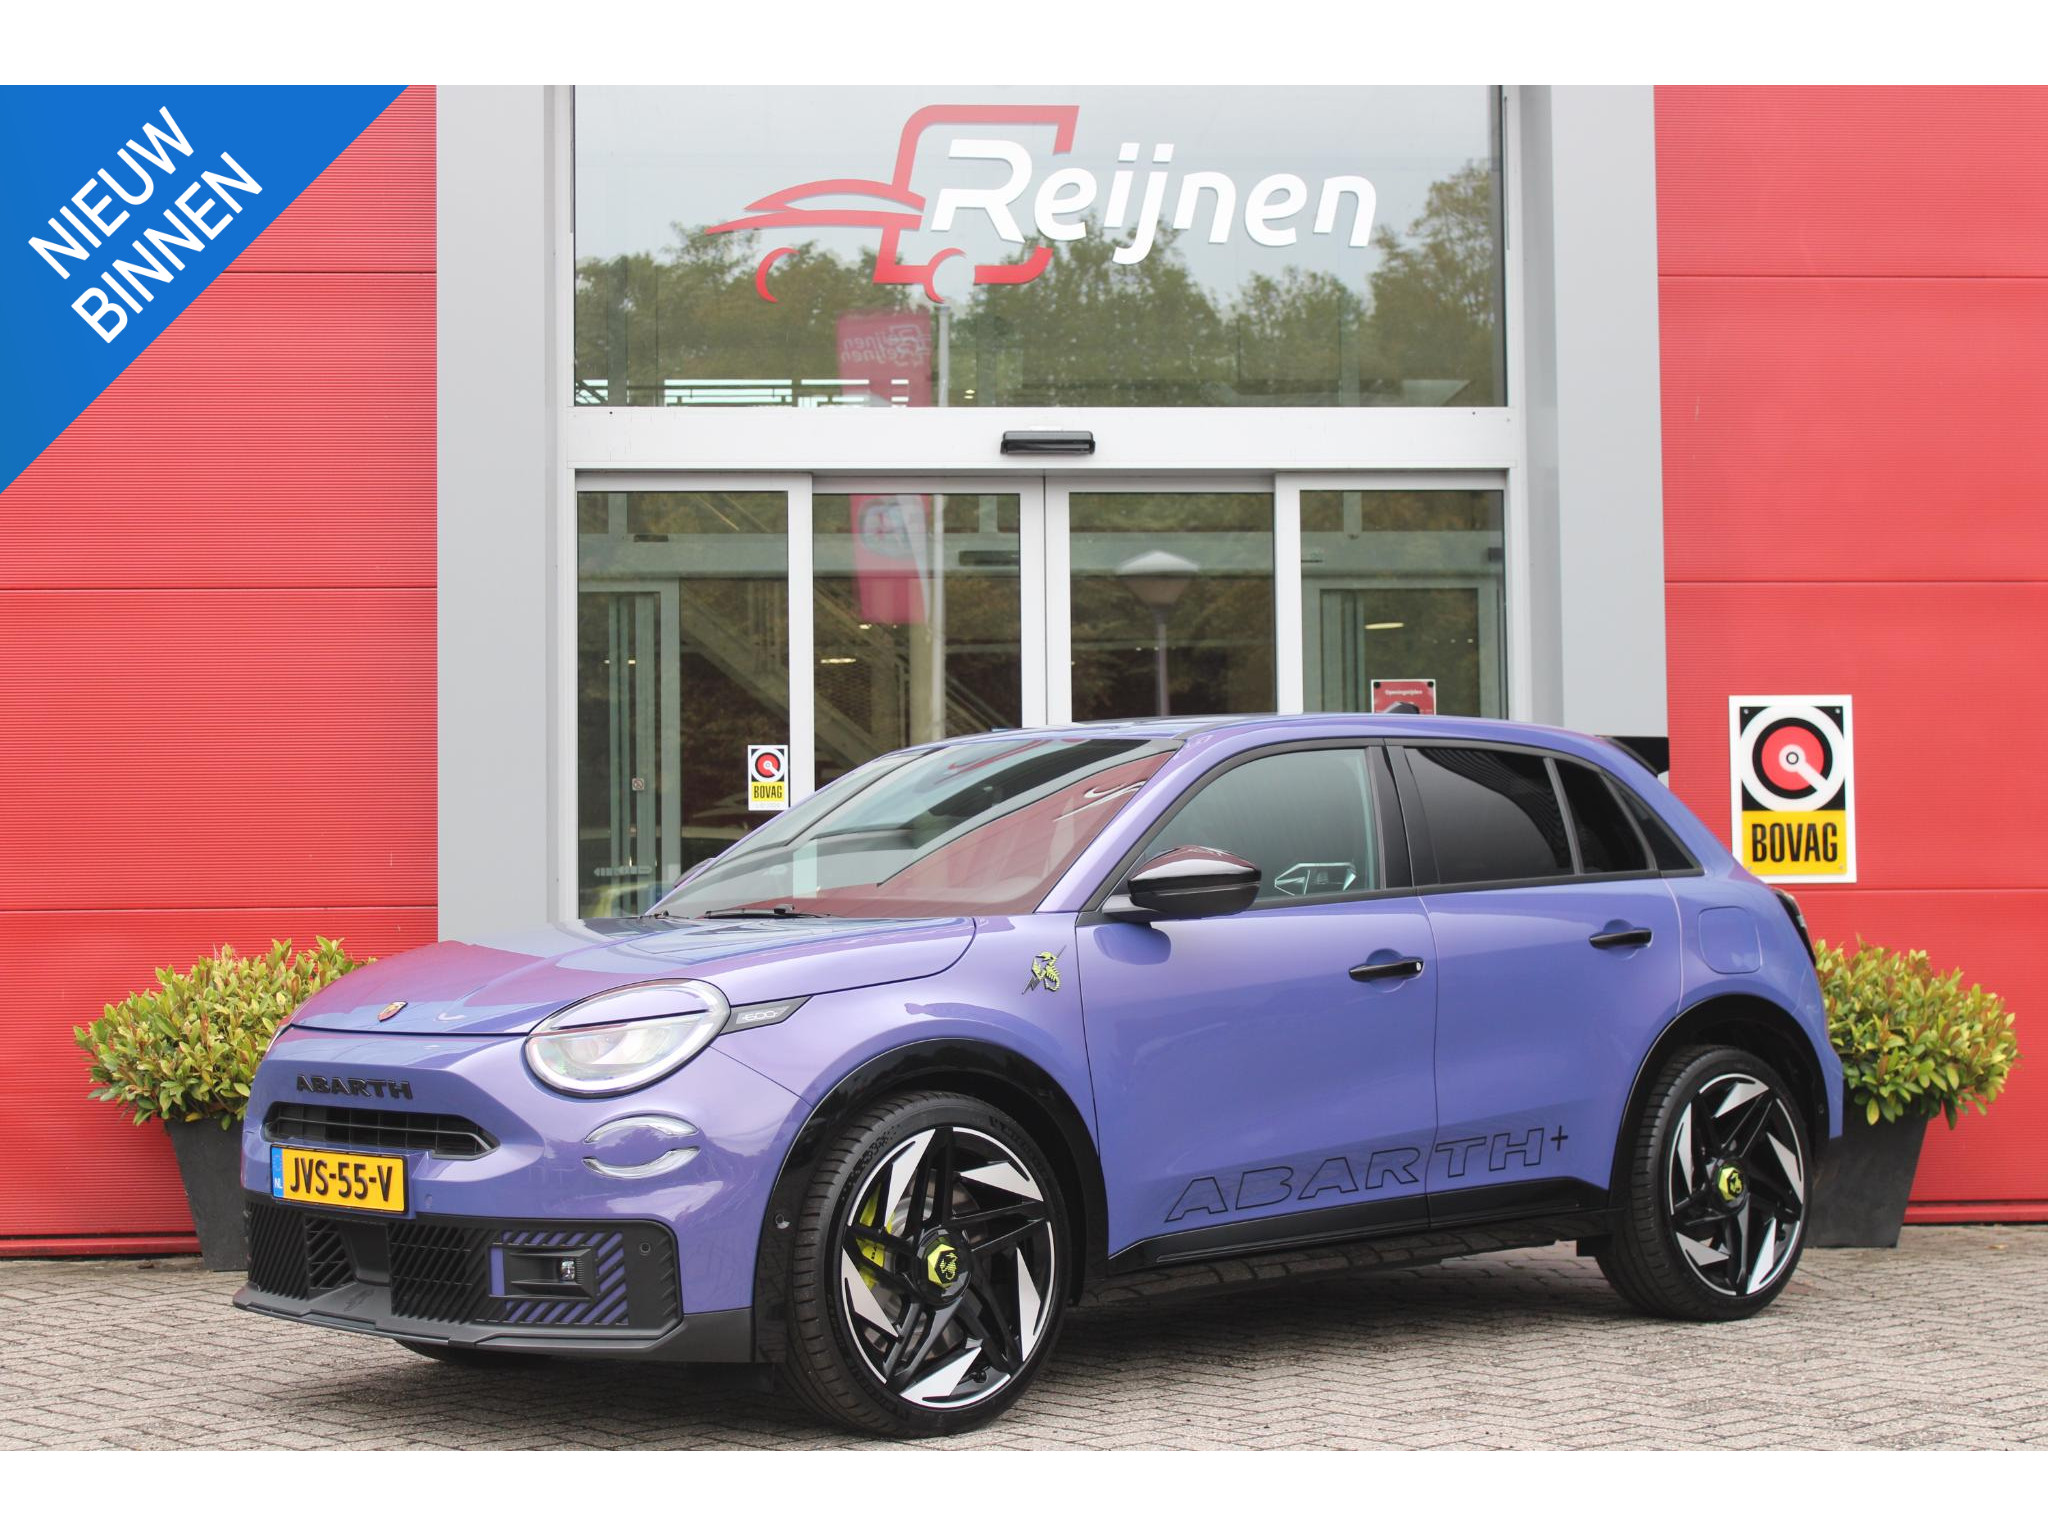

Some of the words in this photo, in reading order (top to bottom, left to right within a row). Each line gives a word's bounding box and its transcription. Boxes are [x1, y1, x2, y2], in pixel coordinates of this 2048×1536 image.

[931, 138, 1377, 266] Reijnen
[753, 785, 783, 799] BOVAG
[1751, 822, 1838, 863] BOVAG
[296, 1074, 413, 1100] ABARTH
[274, 1178, 283, 1190] NL
[290, 1157, 393, 1202] JVS-55-V
